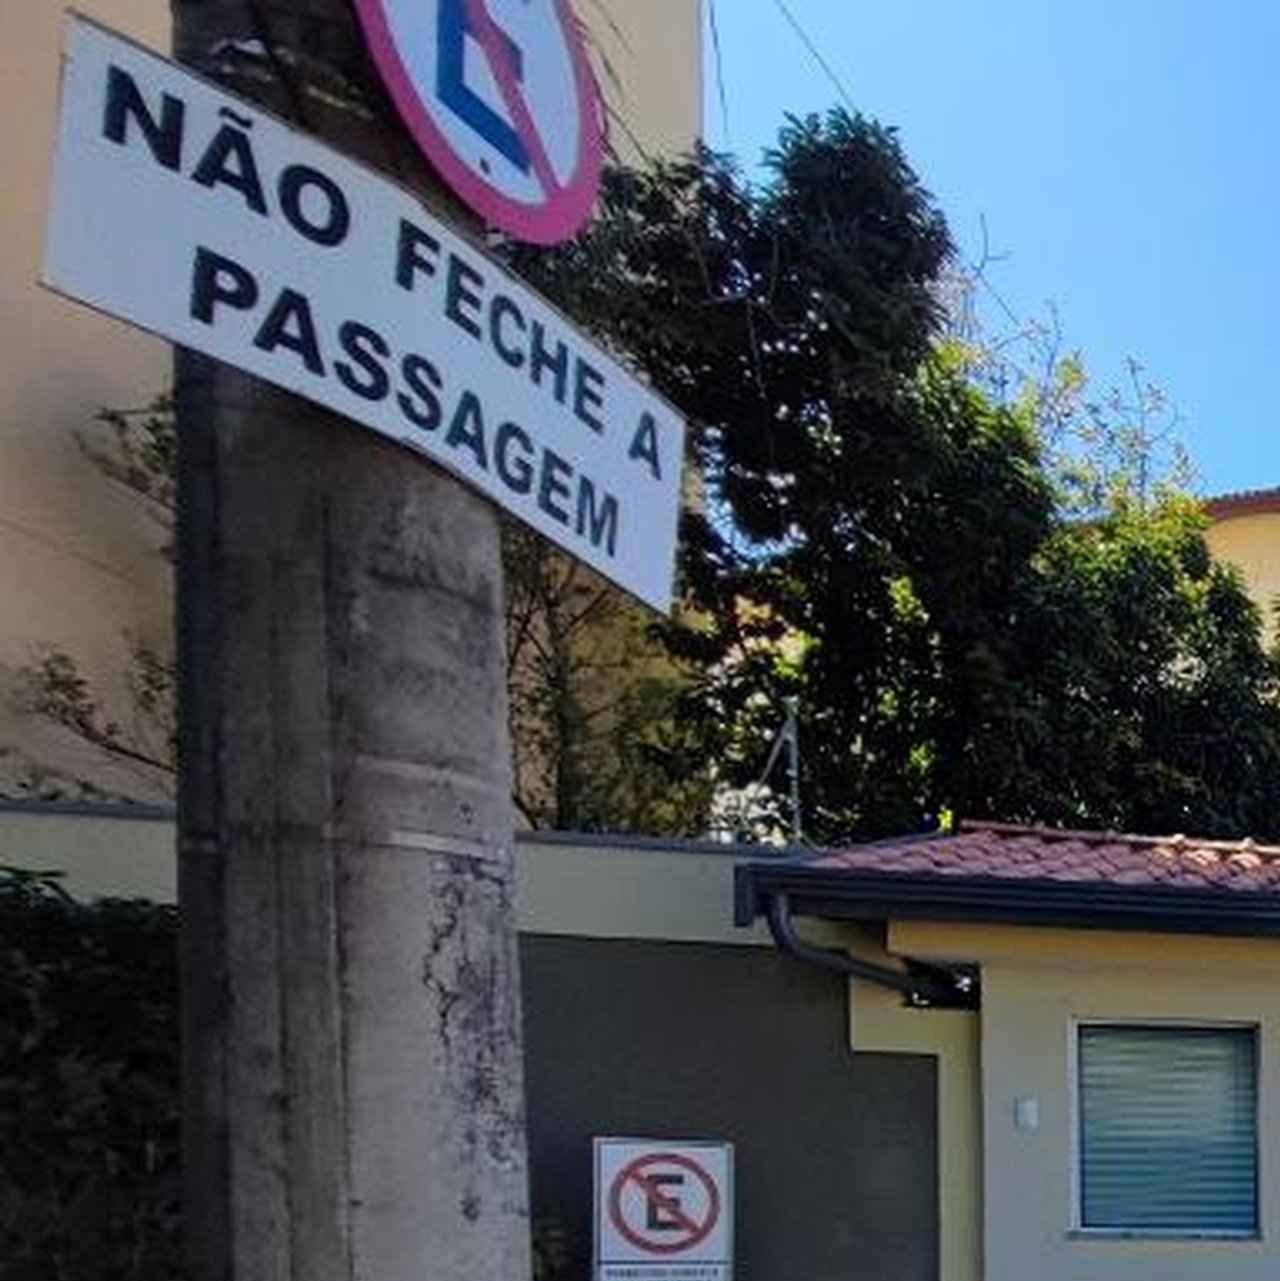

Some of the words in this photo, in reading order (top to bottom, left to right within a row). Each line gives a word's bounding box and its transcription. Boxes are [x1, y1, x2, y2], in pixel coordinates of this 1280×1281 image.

[102, 64, 351, 248] NÃO
[393, 217, 605, 434] FECHE
[627, 409, 663, 481] A
[189, 245, 620, 557] PASSAGEM
[646, 1173, 685, 1230] E
